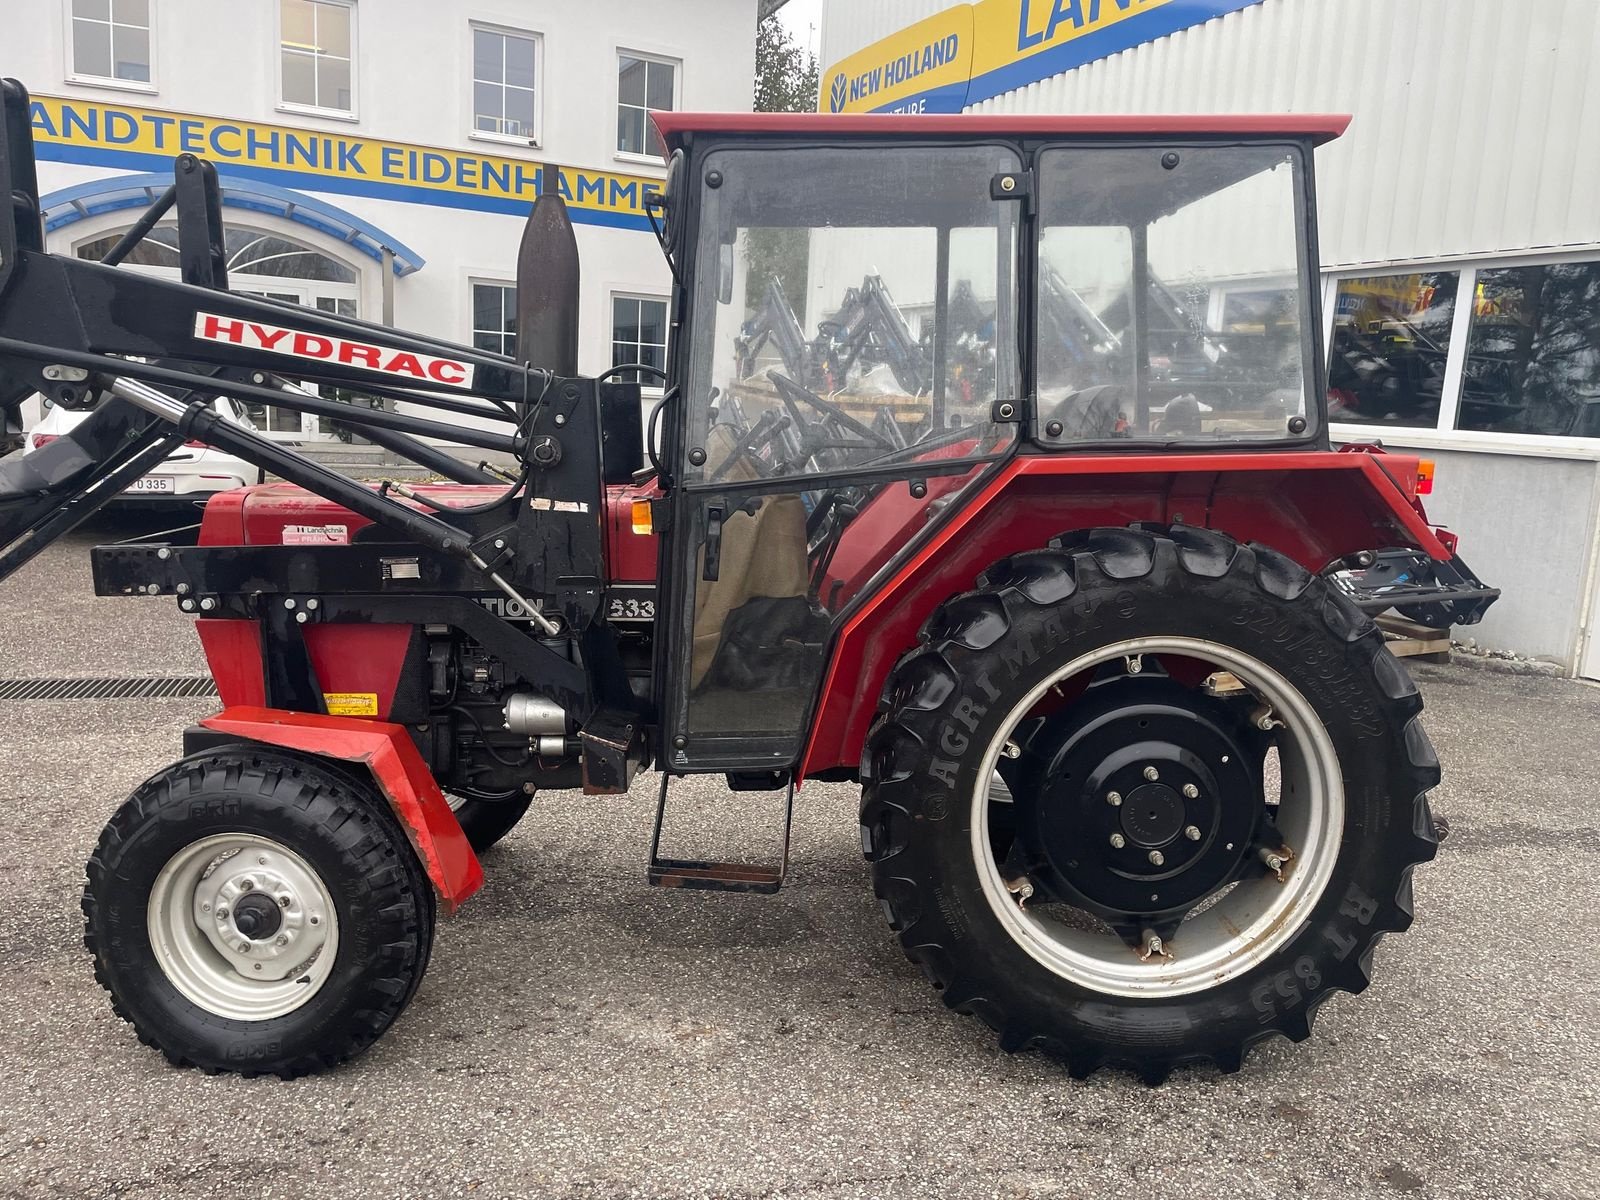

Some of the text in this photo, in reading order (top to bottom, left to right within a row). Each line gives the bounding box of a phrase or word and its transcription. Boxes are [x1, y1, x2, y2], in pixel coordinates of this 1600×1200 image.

[850, 33, 959, 102] NEW HOLLAND
[203, 316, 466, 384] HYDRAC
[146, 480, 167, 489] 335
[473, 598, 544, 617] TION
[610, 598, 656, 618] 533
